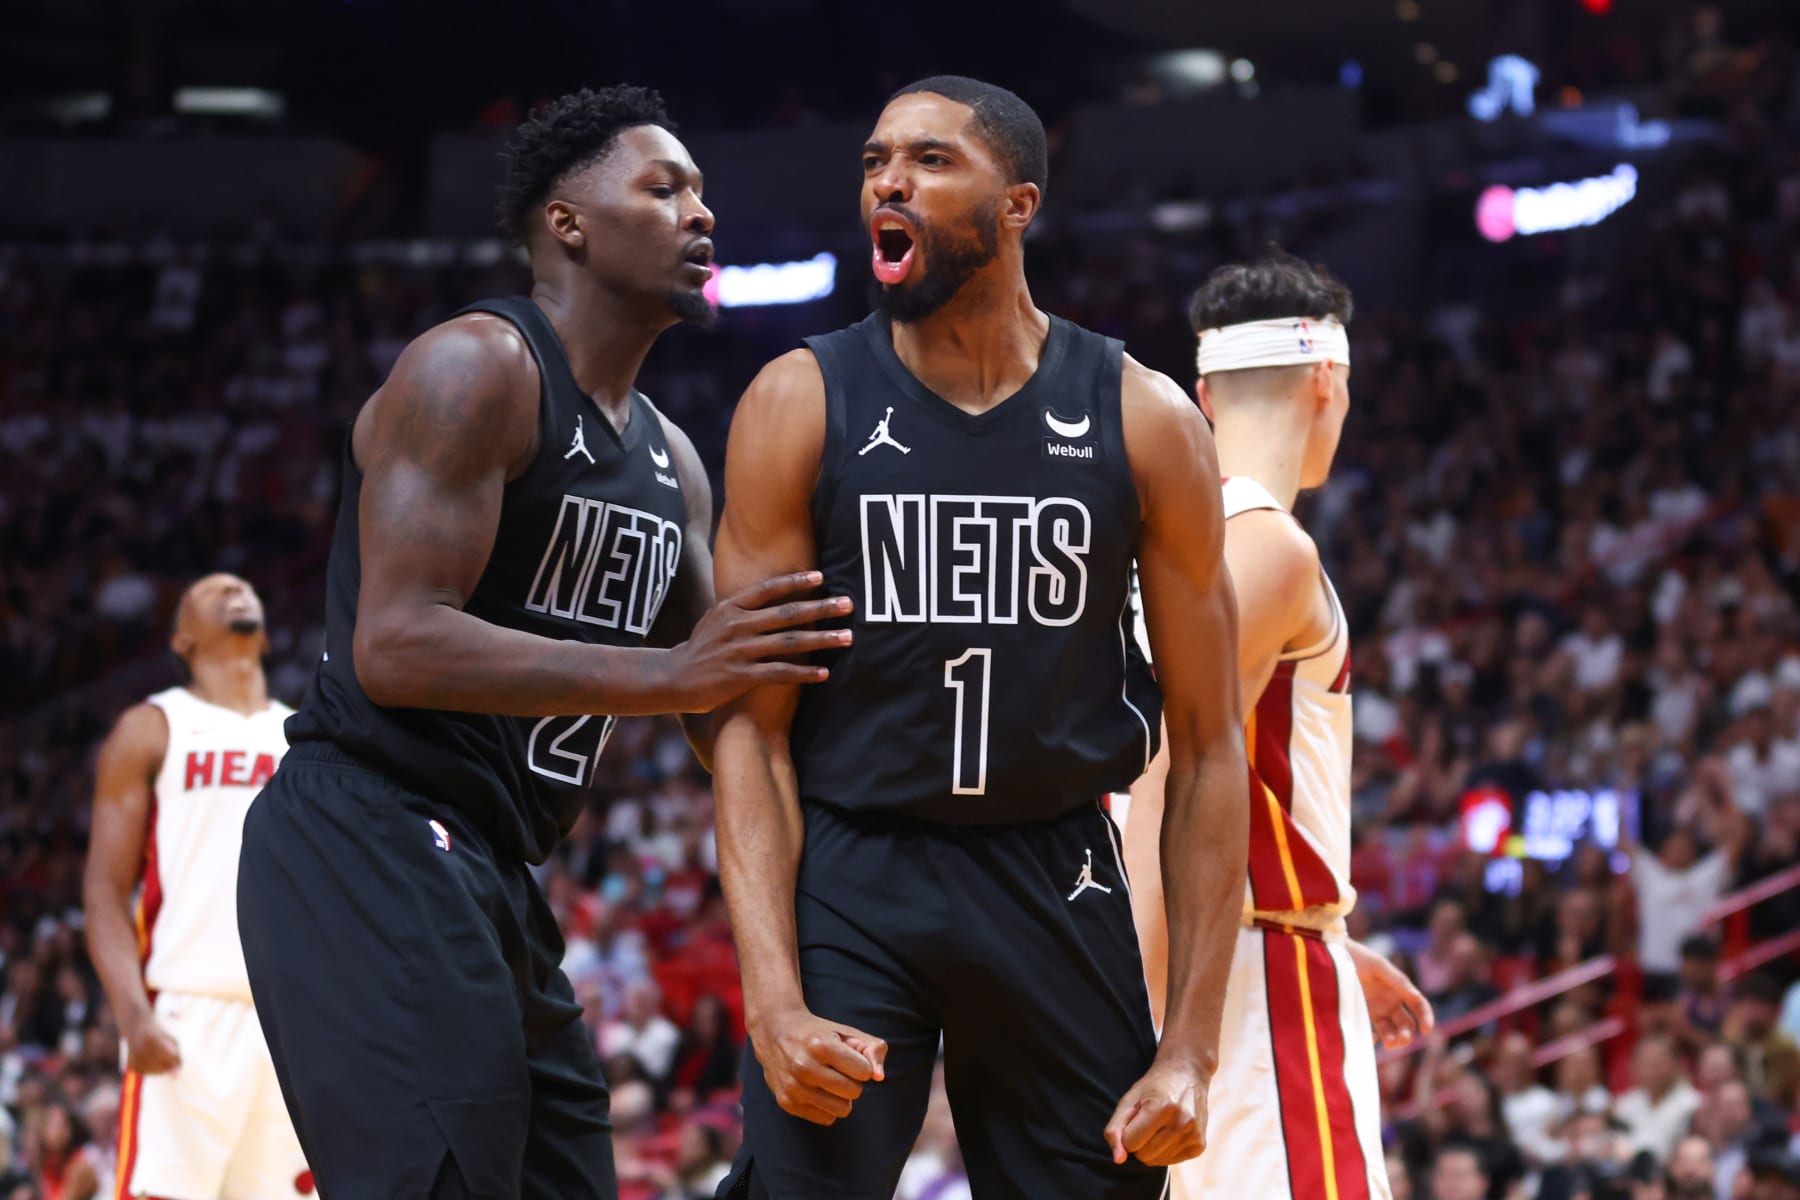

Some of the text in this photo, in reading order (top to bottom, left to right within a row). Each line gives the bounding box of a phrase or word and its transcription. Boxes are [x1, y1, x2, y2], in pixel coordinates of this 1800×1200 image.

[1047, 442, 1093, 459] Webull
[524, 494, 682, 638] NETS
[859, 494, 1092, 627] NETS
[183, 750, 276, 792] HEA
[527, 714, 617, 786] 2
[944, 647, 992, 795] 1
